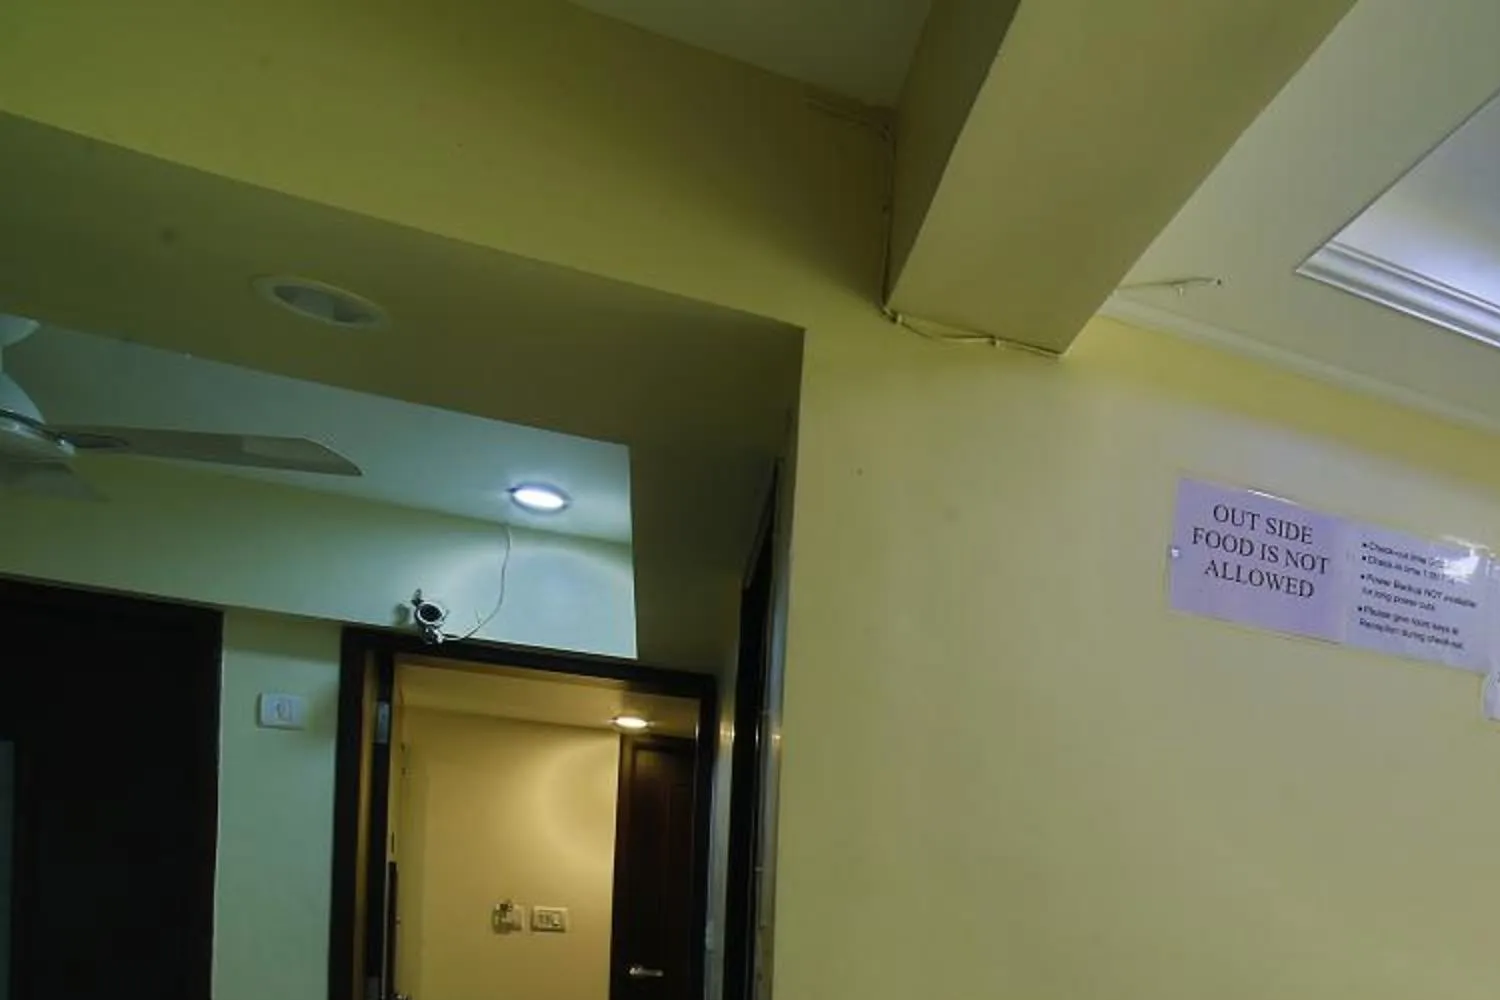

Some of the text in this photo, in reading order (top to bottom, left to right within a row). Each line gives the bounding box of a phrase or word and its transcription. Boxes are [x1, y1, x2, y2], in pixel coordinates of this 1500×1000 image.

[1213, 503, 1313, 544] OUT SIDE
[1192, 526, 1329, 574] FOOD IS NOT
[1204, 558, 1315, 599] ALLOWED
[1366, 573, 1391, 587] Power
[1423, 588, 1442, 599] NOT
